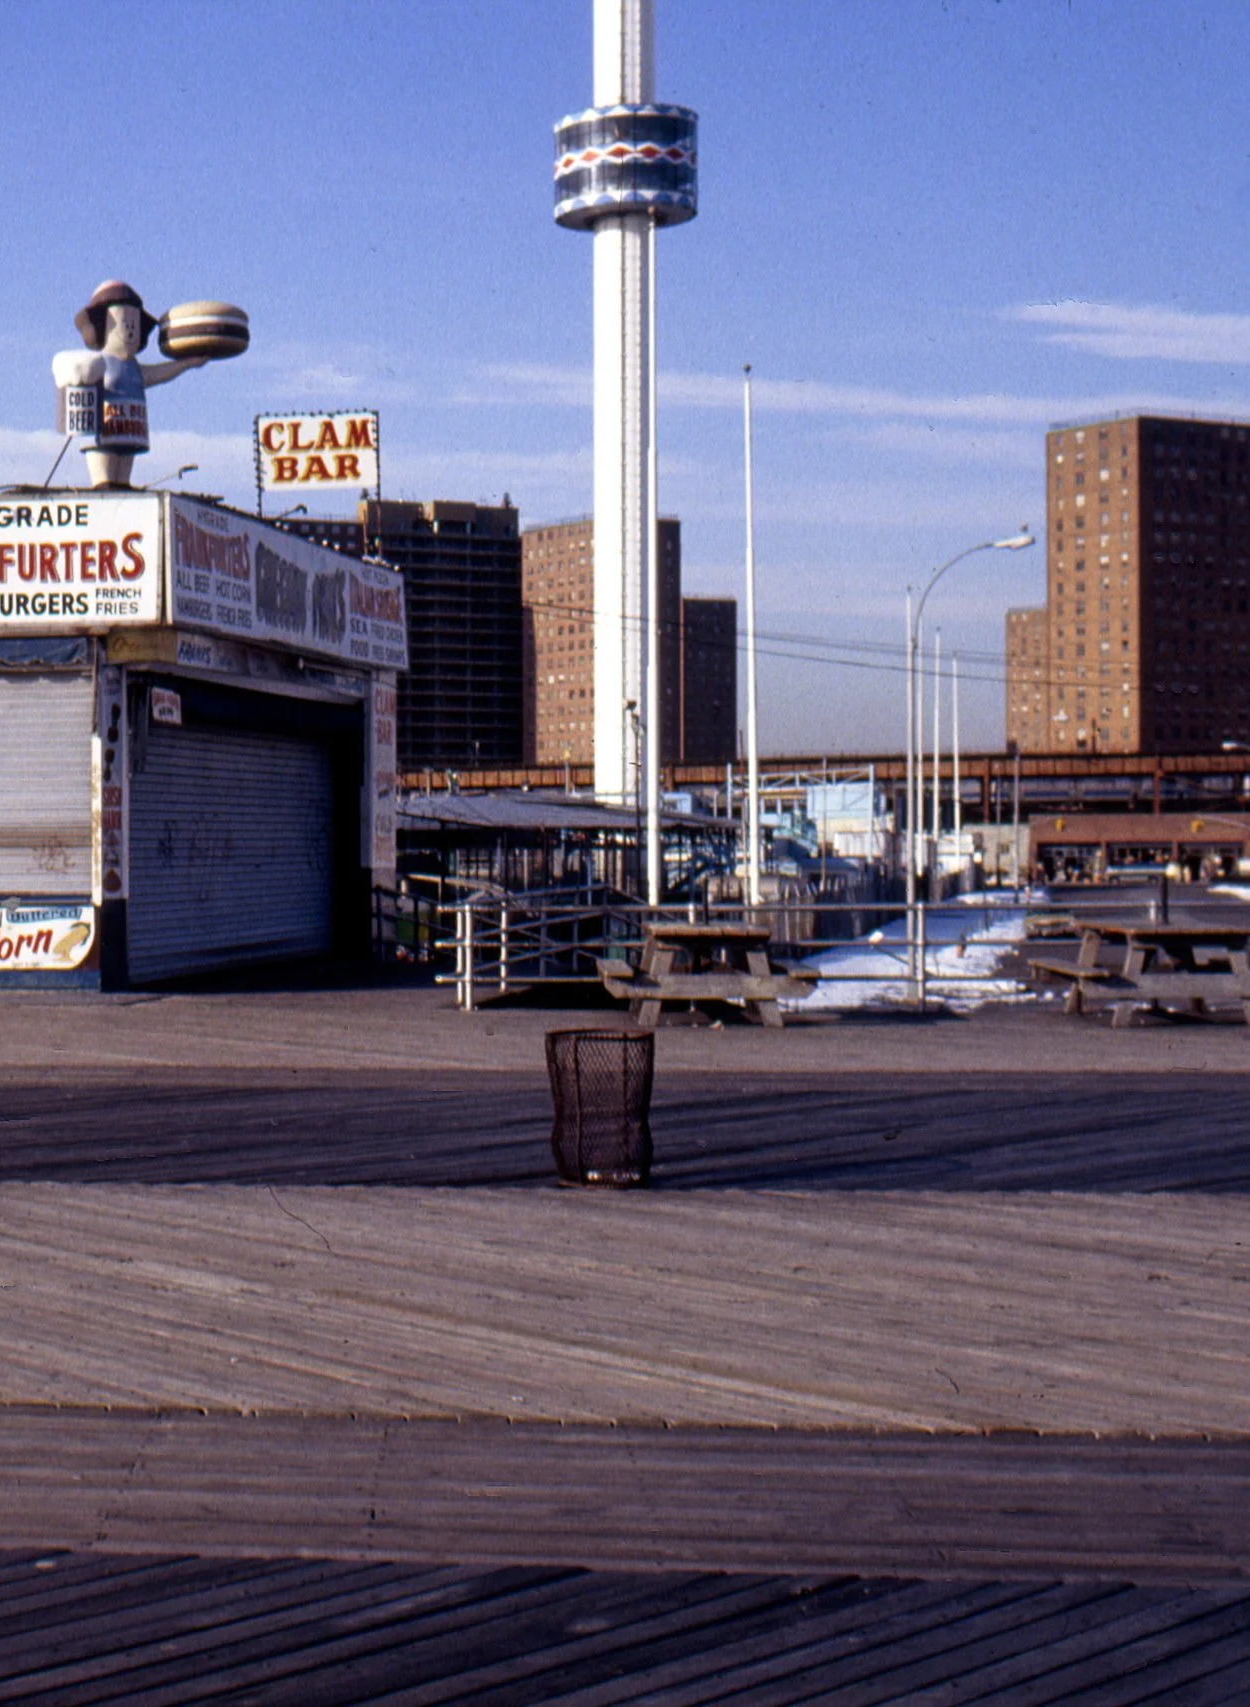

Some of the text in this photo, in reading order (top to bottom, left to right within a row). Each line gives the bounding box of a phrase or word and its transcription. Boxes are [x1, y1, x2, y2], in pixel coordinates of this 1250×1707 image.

[69, 391, 95, 407] COLD
[69, 410, 95, 432] BEER
[262, 418, 374, 455] CLAM
[272, 453, 361, 483] BAR
[95, 588, 141, 599] FRENCH
[95, 602, 138, 615] FRIES
